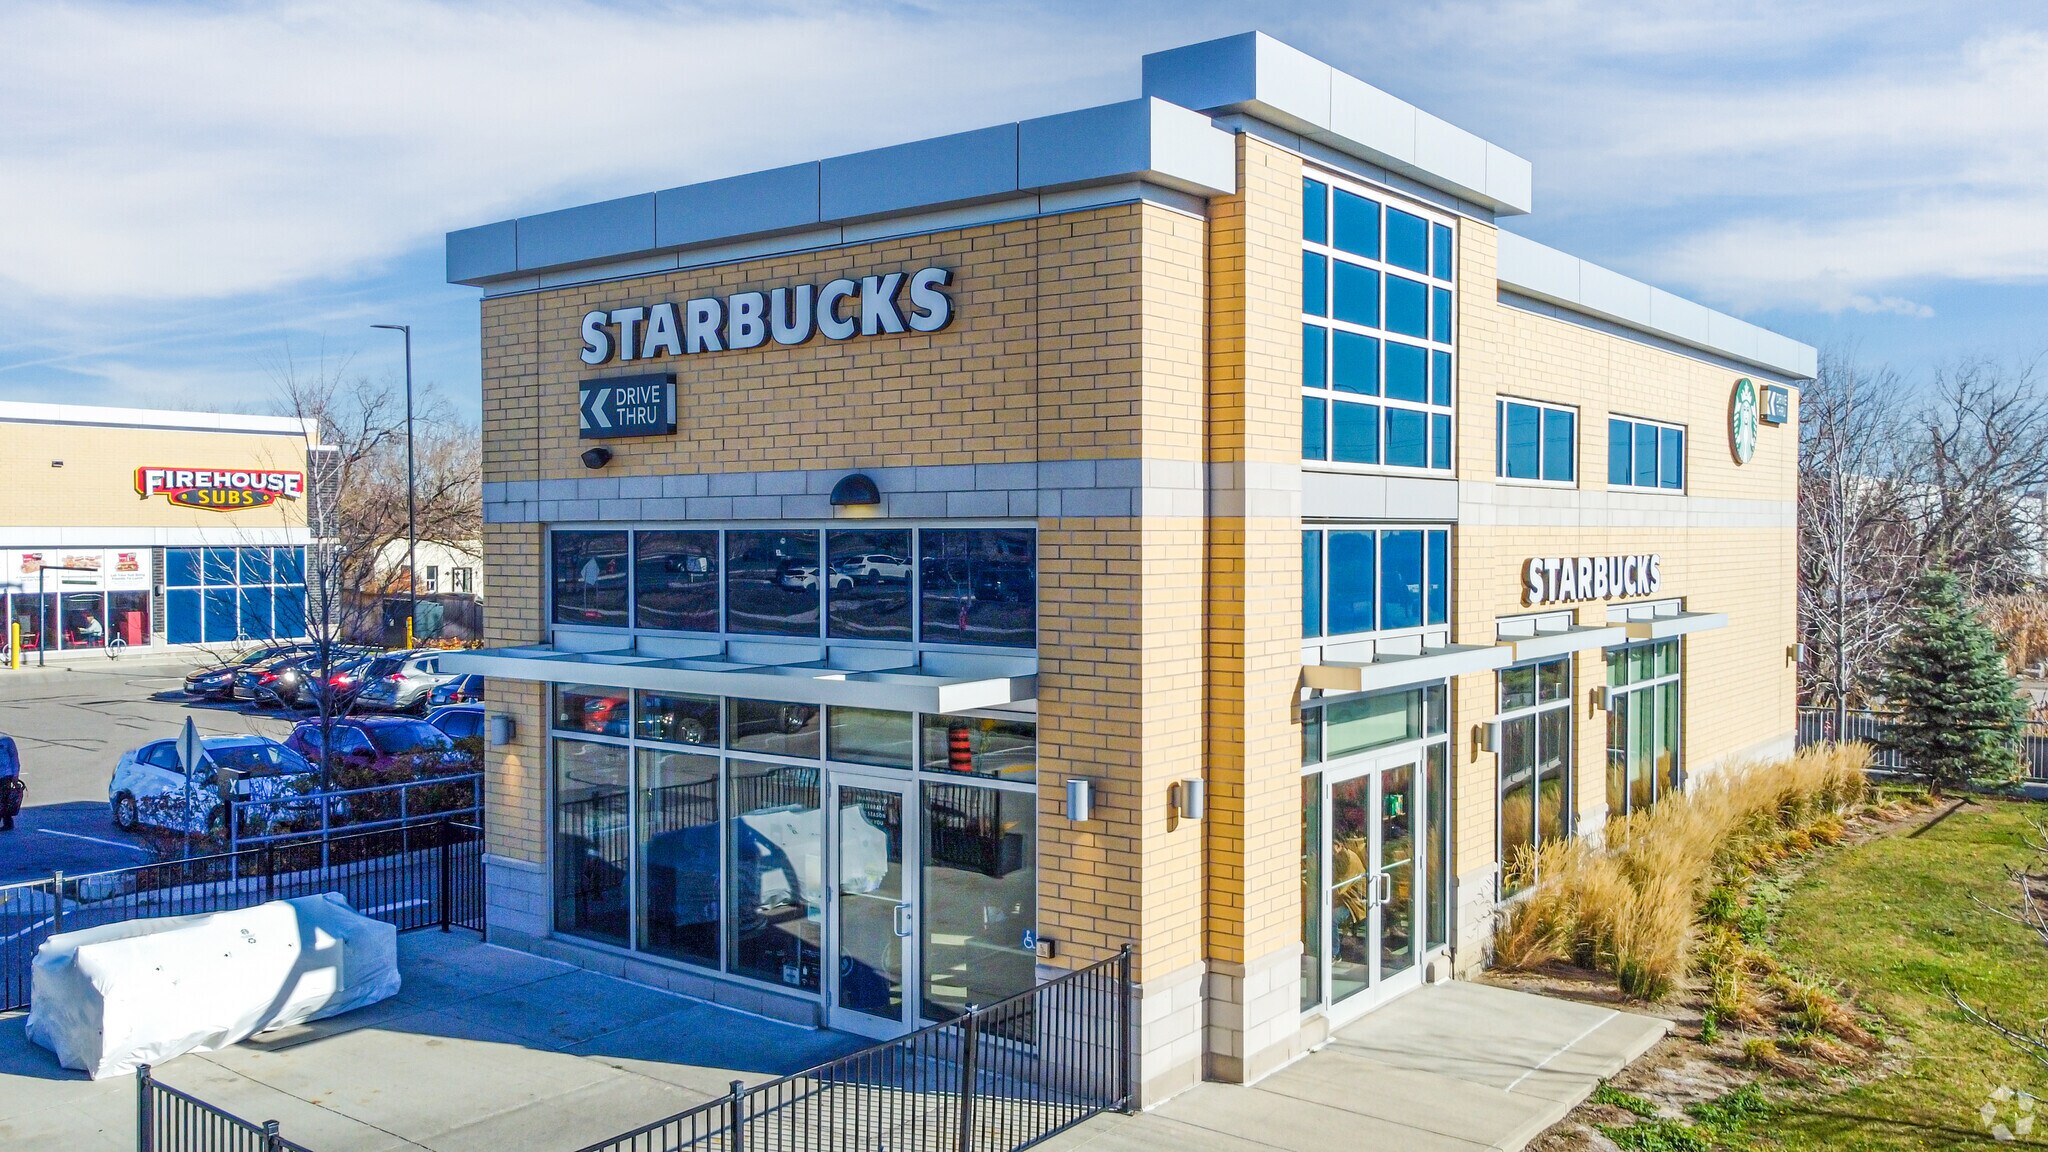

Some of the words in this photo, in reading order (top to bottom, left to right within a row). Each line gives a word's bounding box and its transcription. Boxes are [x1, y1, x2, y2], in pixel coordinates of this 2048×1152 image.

[579, 267, 953, 365] STARBUCKS
[616, 385, 660, 406] DRIVE
[616, 405, 657, 426] THRU
[145, 469, 301, 498] FIREHOUSE
[197, 489, 253, 504] SUBS
[1528, 554, 1661, 604] STARBUCKS
